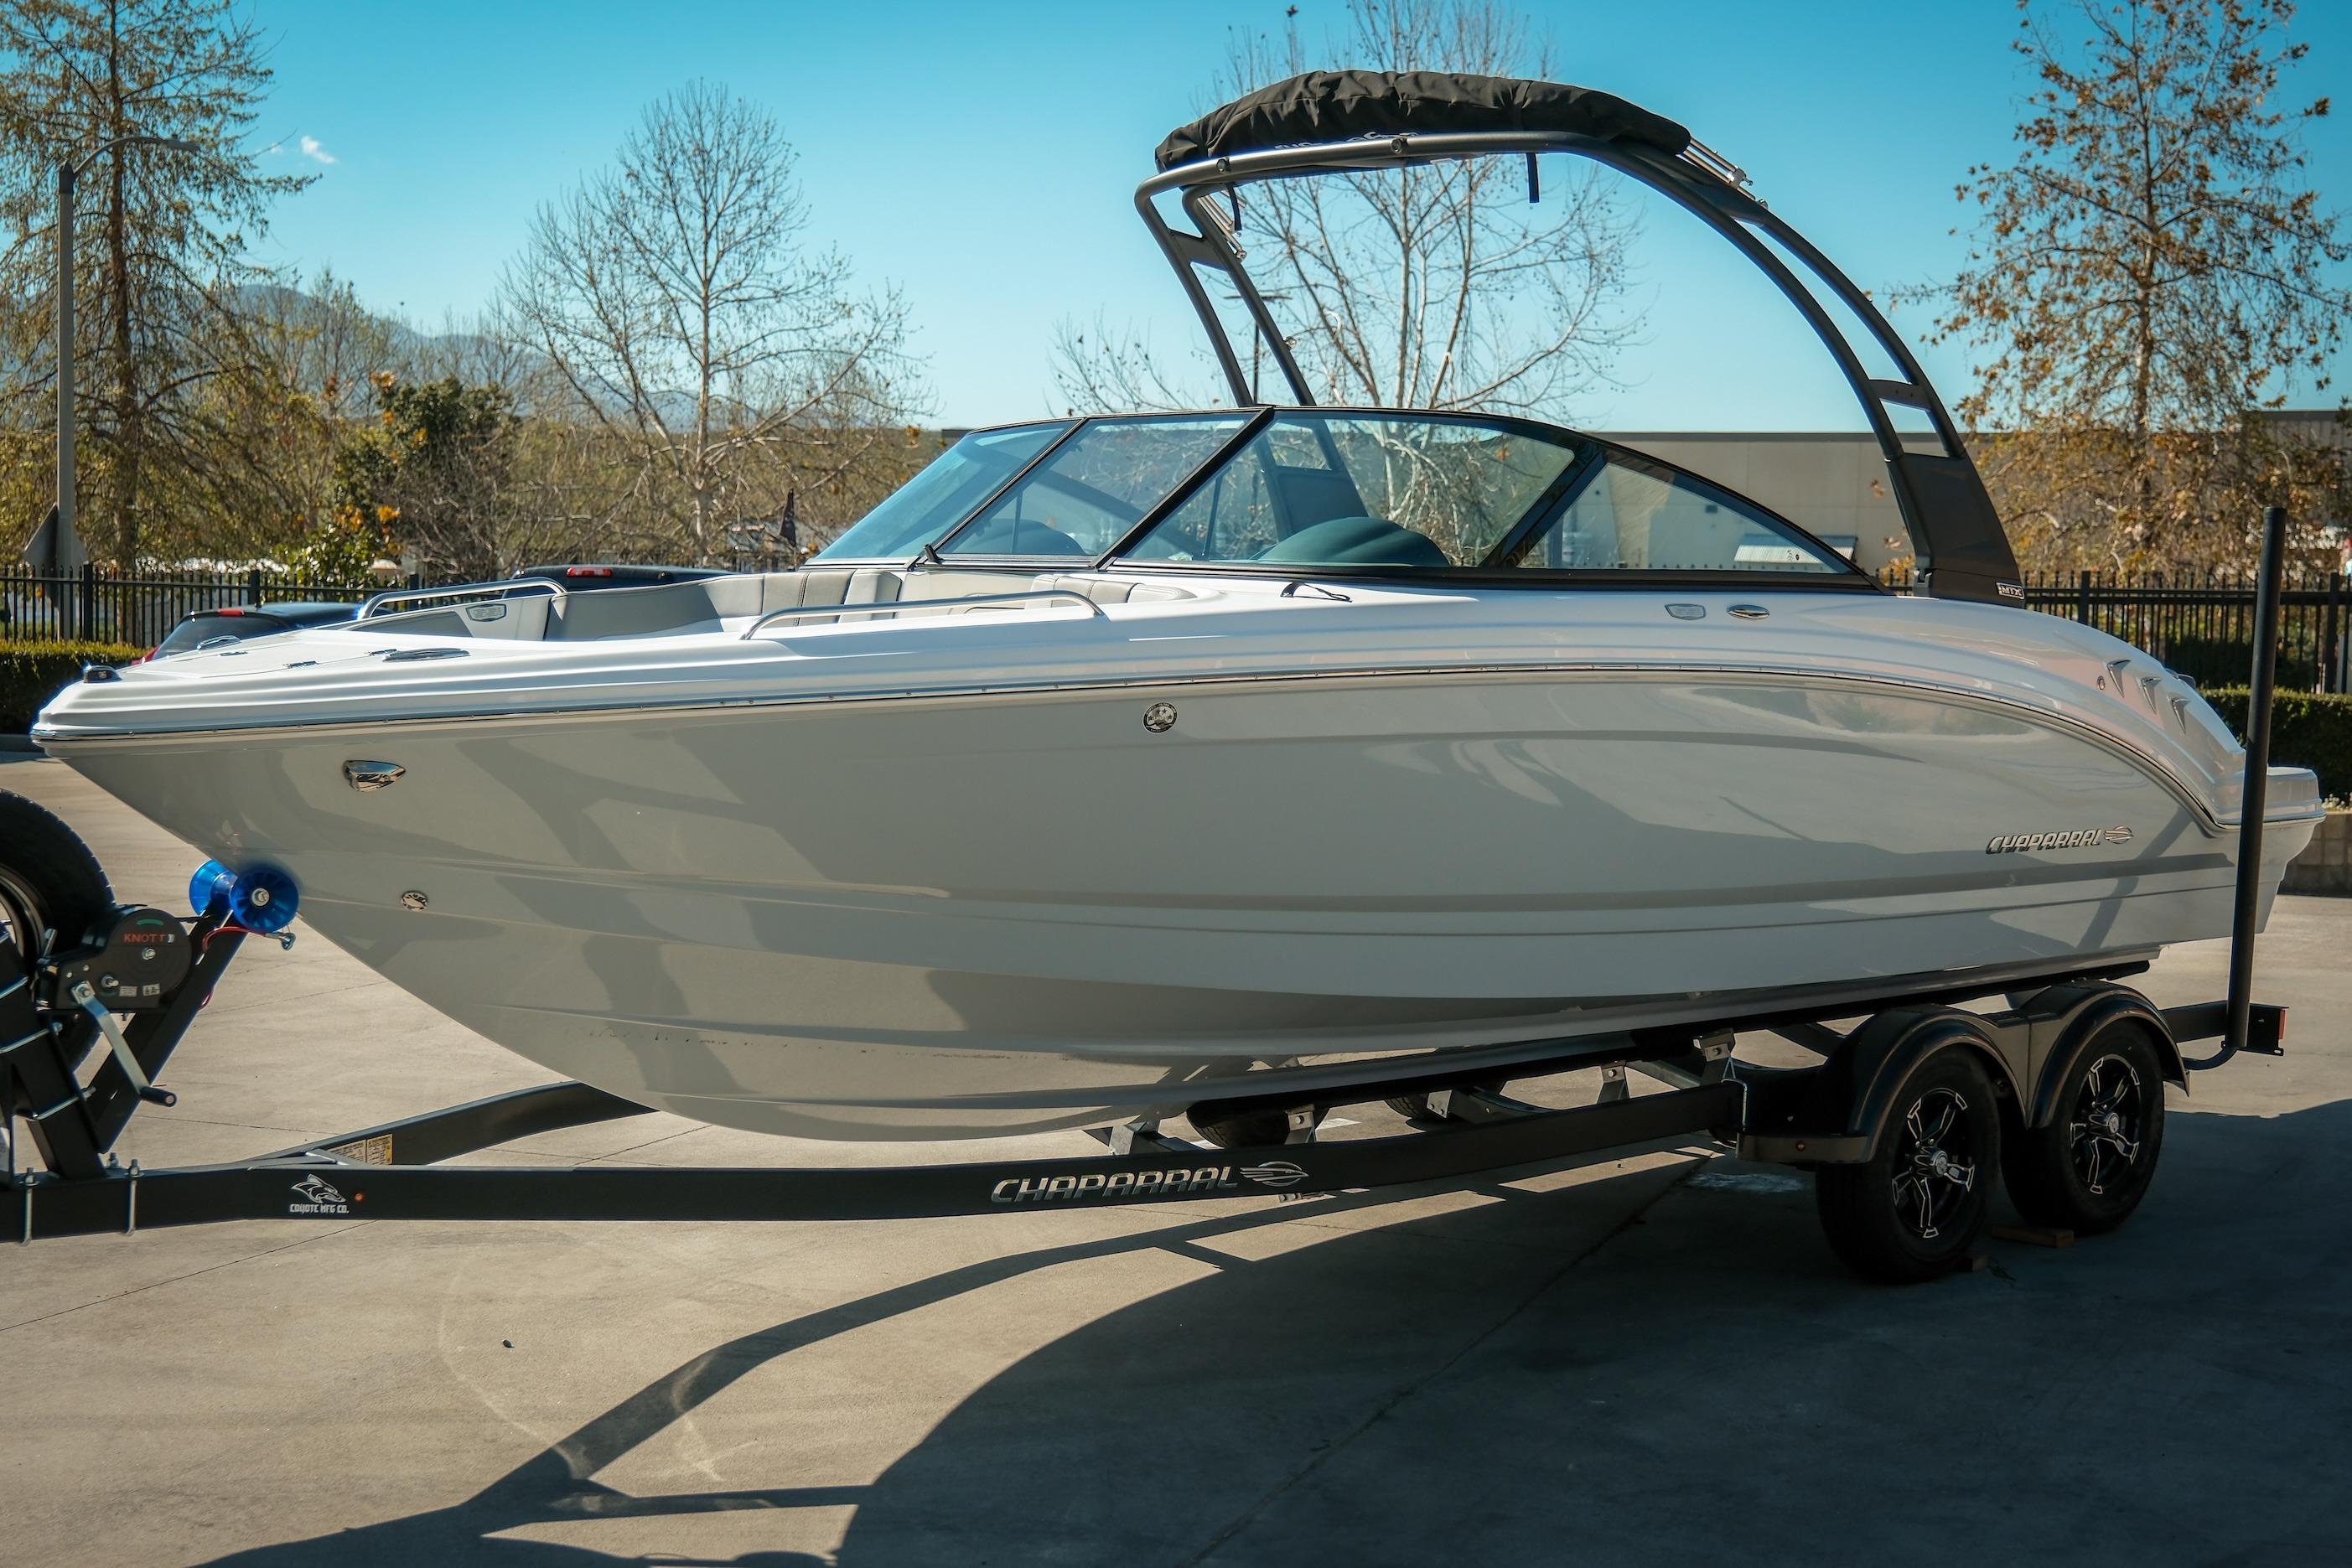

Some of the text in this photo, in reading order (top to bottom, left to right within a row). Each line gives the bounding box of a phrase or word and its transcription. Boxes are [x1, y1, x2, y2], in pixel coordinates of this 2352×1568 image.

[1986, 828, 2103, 855] CHAPARRAL
[123, 933, 167, 943] KNOTT
[991, 1166, 1238, 1203] CHAPARRAL
[289, 1203, 350, 1214] COYOTE MFG CO.
